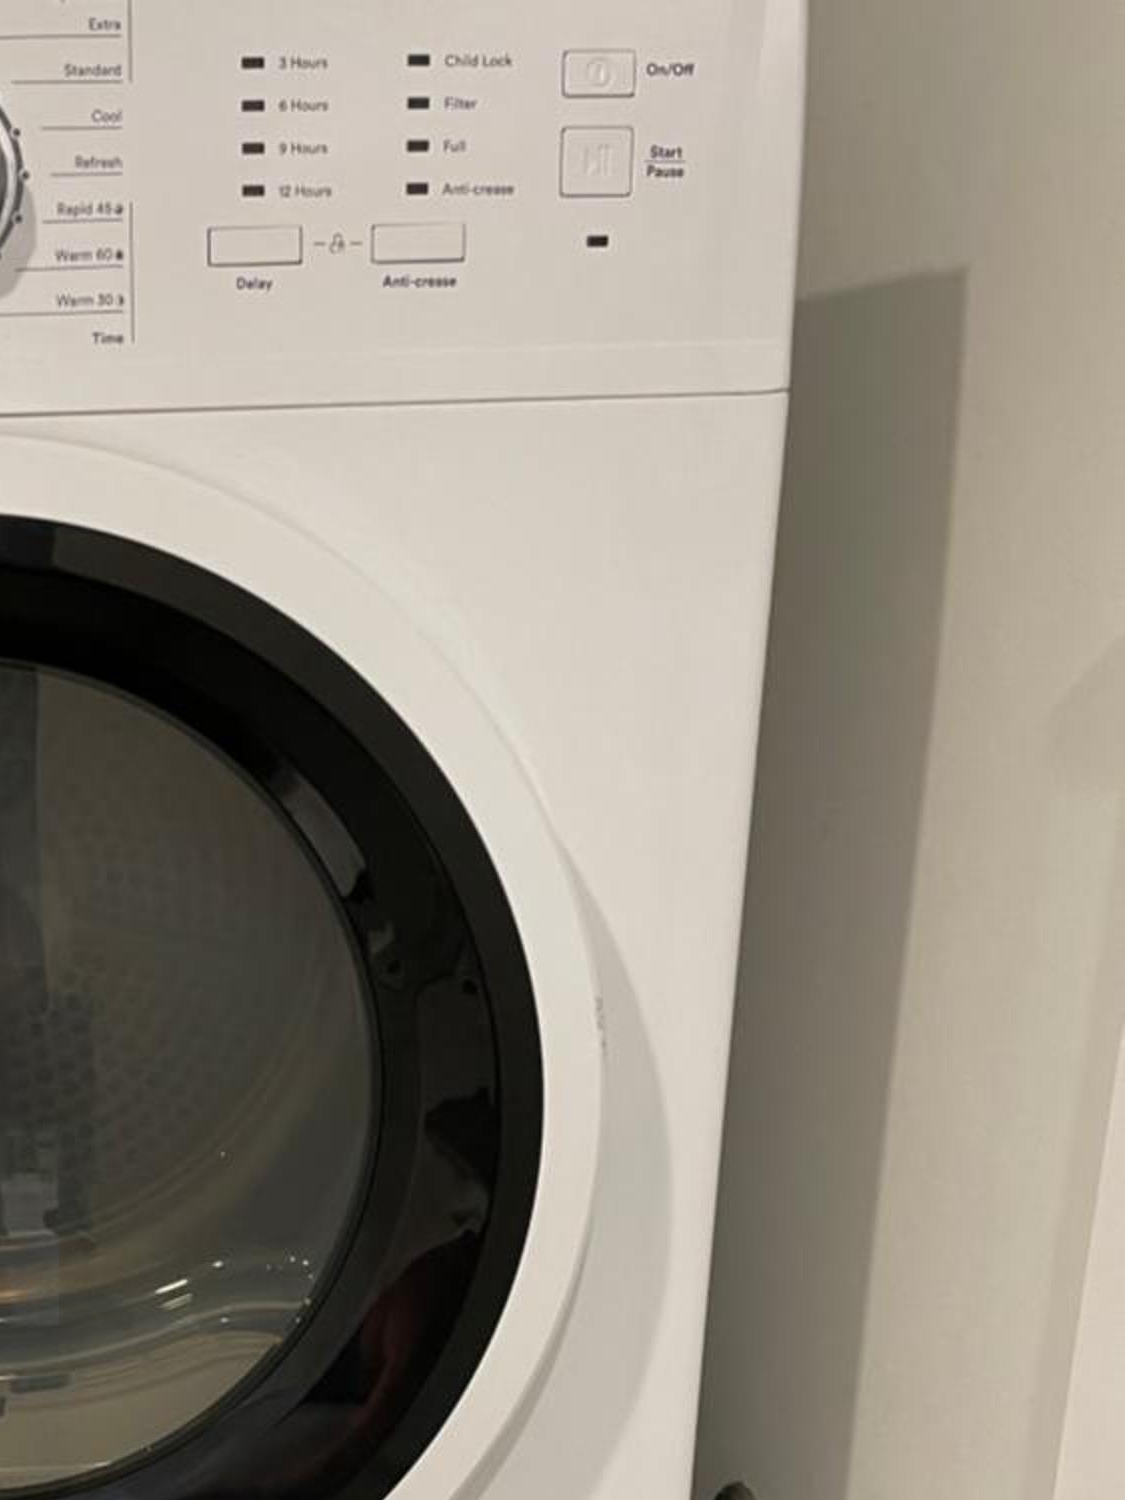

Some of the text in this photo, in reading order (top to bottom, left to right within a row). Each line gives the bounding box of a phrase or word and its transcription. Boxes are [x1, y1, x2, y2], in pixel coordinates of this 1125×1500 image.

[88, 18, 121, 31] Extra
[278, 56, 328, 70] 3 Hours
[444, 53, 513, 68] Child Lock
[64, 63, 122, 78] Standard
[646, 61, 694, 77] On/Off
[290, 99, 329, 112] Hours
[444, 96, 477, 111] Filter
[91, 109, 122, 123] Cool
[290, 142, 328, 155] Hours
[443, 139, 466, 153] Full
[650, 145, 683, 159] Start
[74, 155, 122, 169] Refresh
[646, 165, 685, 179] Pause
[278, 184, 332, 198] 12 Hours
[442, 182, 515, 196] Anti-crease
[57, 202, 93, 217] Rapid
[55, 249, 92, 262] Warm
[236, 277, 273, 292] Delay
[382, 274, 457, 289] Anti-crease
[56, 295, 94, 308] Warm
[92, 331, 124, 344] Time
